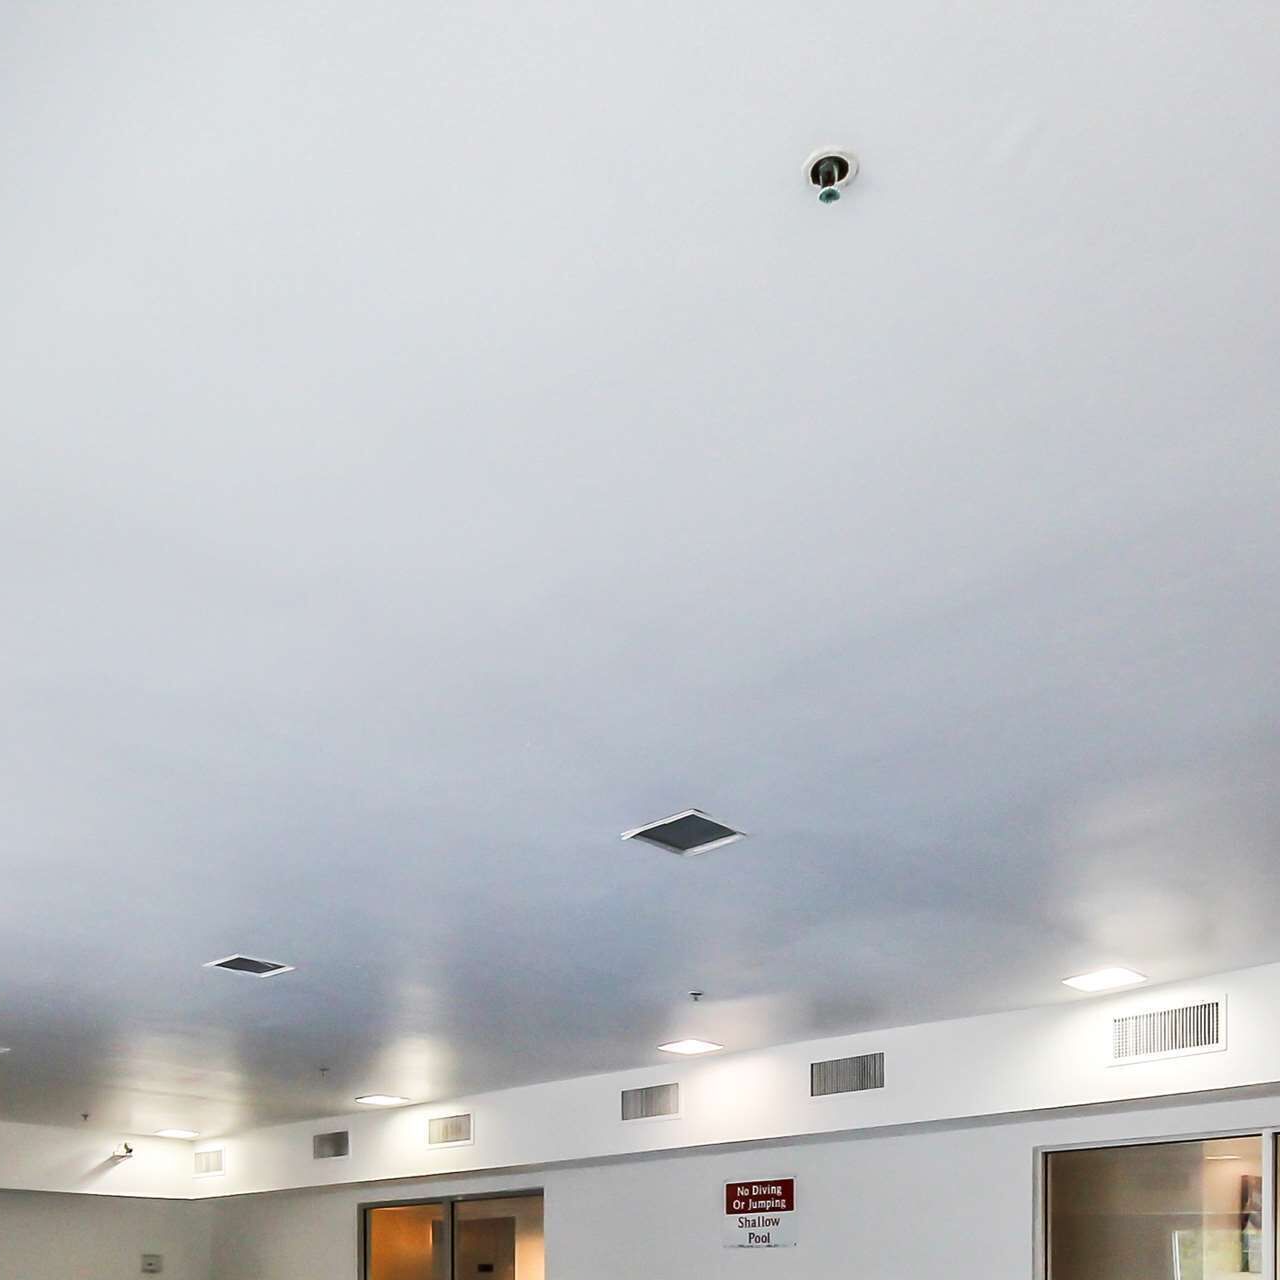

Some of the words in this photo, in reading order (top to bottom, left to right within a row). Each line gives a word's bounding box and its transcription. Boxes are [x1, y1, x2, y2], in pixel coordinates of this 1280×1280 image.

[736, 1186, 750, 1197] No
[752, 1184, 783, 1197] Diving
[732, 1200, 746, 1210] Or
[748, 1198, 787, 1211] Jumping
[737, 1215, 781, 1229] Shallow
[748, 1232, 771, 1244] Pool
